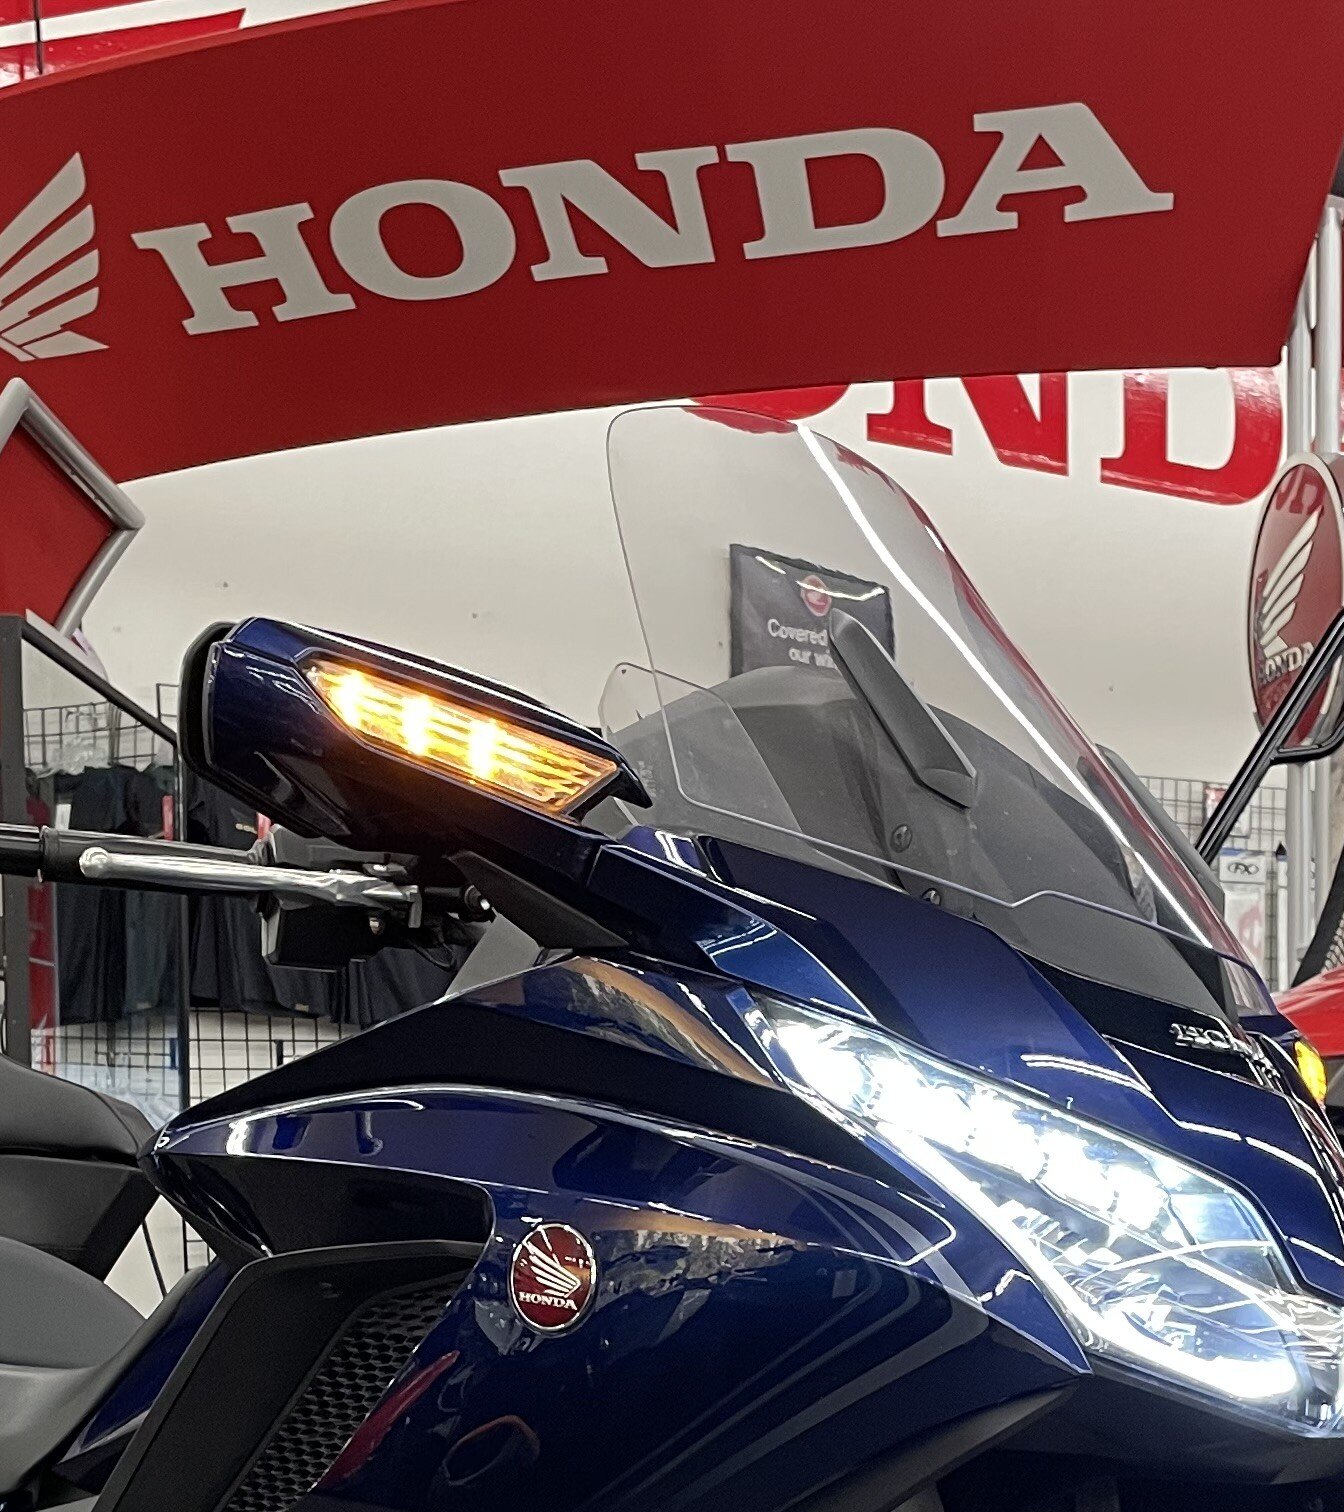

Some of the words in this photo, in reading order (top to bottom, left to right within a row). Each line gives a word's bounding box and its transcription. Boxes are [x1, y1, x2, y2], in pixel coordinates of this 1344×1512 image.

[131, 101, 1175, 337] HONDA
[767, 618, 829, 647] Covered
[788, 648, 812, 664] our
[518, 1291, 578, 1311] HONDA
